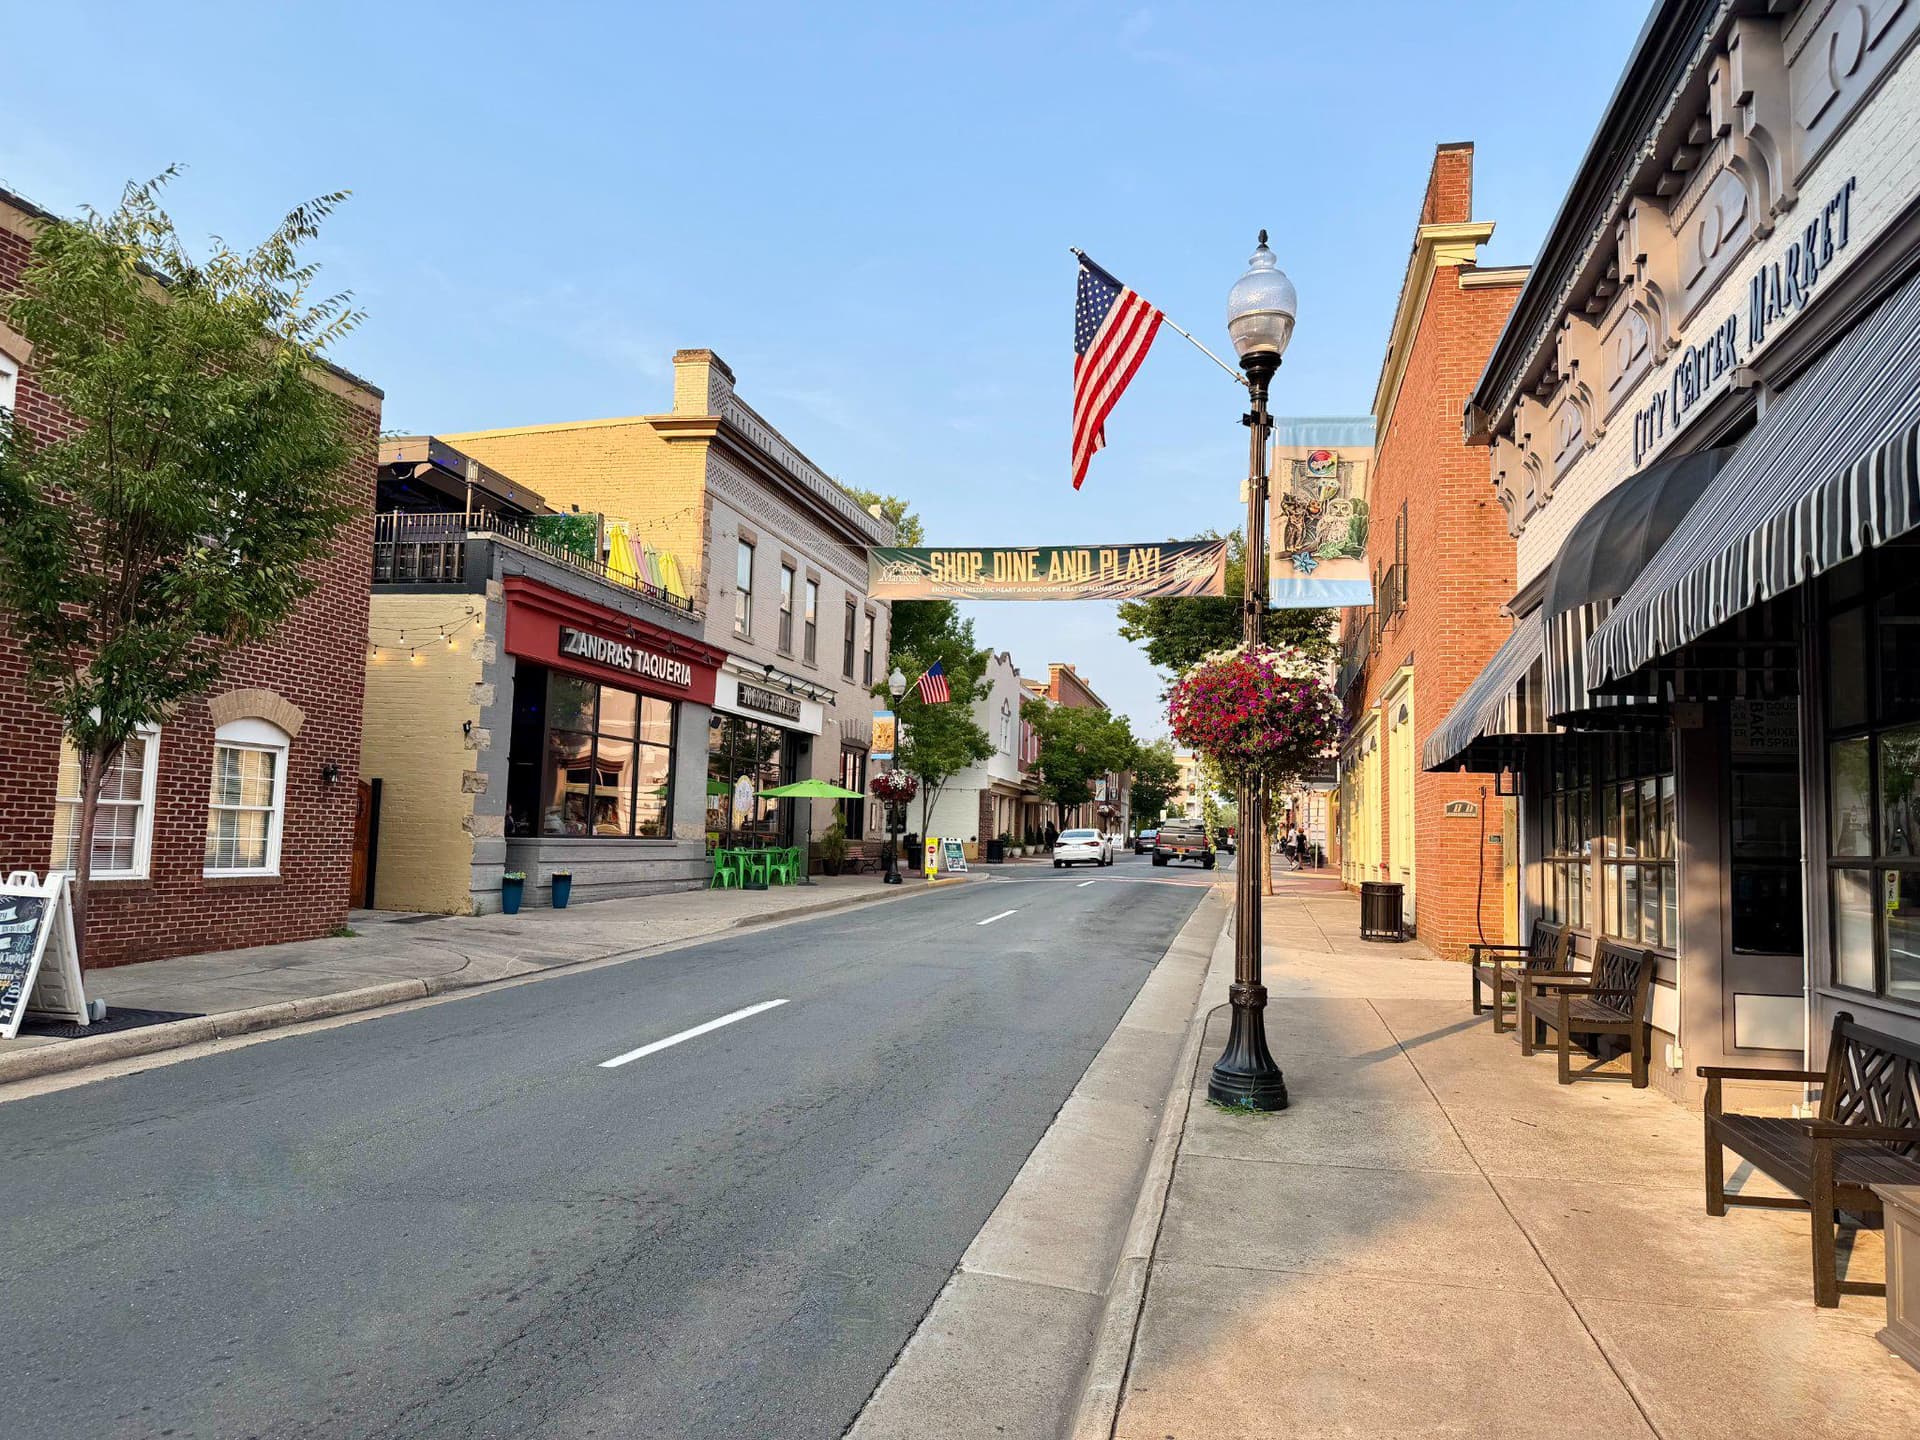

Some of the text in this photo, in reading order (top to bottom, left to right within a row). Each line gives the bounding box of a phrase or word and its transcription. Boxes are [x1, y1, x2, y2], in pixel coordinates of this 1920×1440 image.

[1633, 176, 1856, 468] CITY CENTER MARKET
[930, 551, 985, 584] SHOP,
[993, 551, 1040, 582] DINE
[1047, 550, 1091, 582] AND
[1099, 547, 1161, 581] PLAY!
[564, 628, 691, 687] ZANDRAS TAQUERIA
[1750, 702, 1764, 747] BAKE
